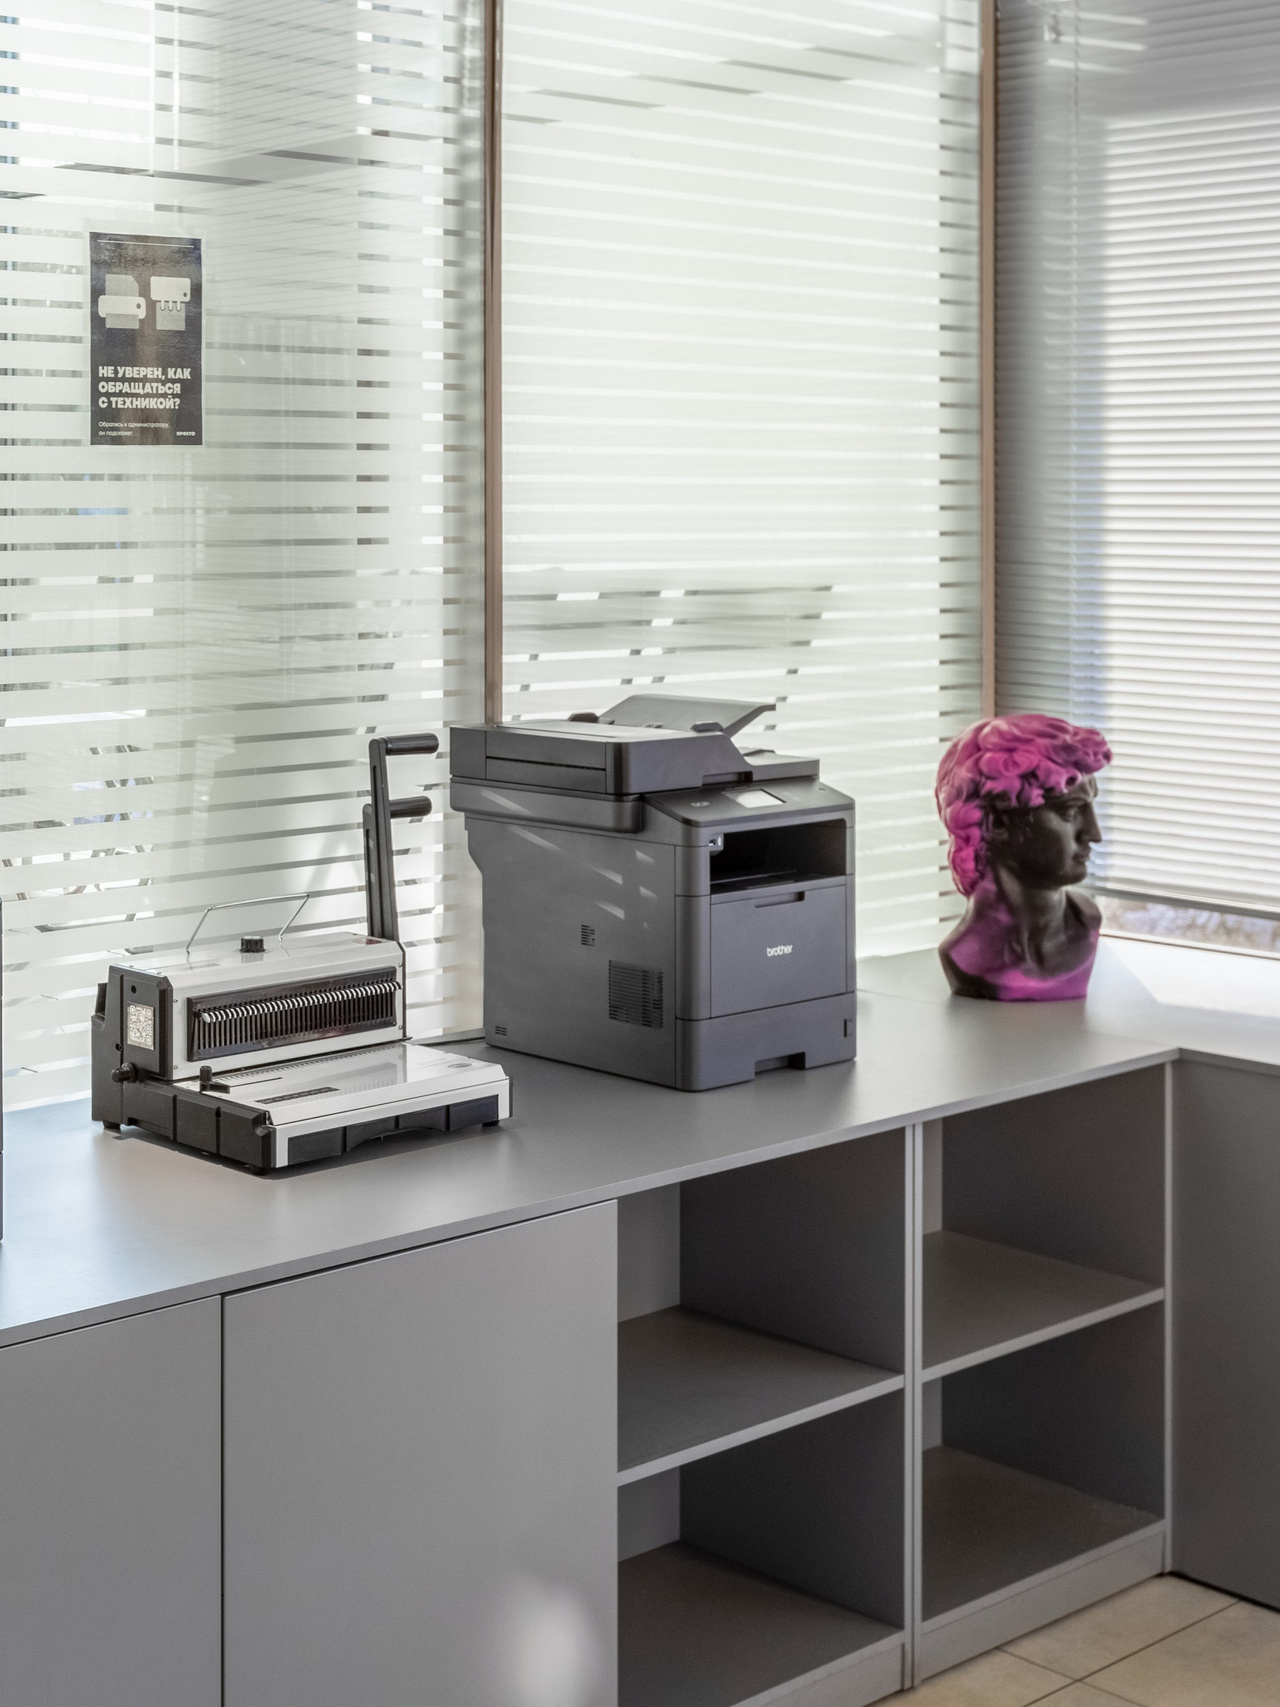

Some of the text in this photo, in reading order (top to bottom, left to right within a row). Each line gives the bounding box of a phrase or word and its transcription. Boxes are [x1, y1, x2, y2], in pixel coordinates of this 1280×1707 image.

[98, 365, 192, 380] НЕ УВЕРЕН, КАК
[98, 381, 181, 395] ОБРАЩАТЬСЯ
[98, 395, 181, 409] С ТЕХНИКОЙ?
[766, 944, 793, 957] brother
